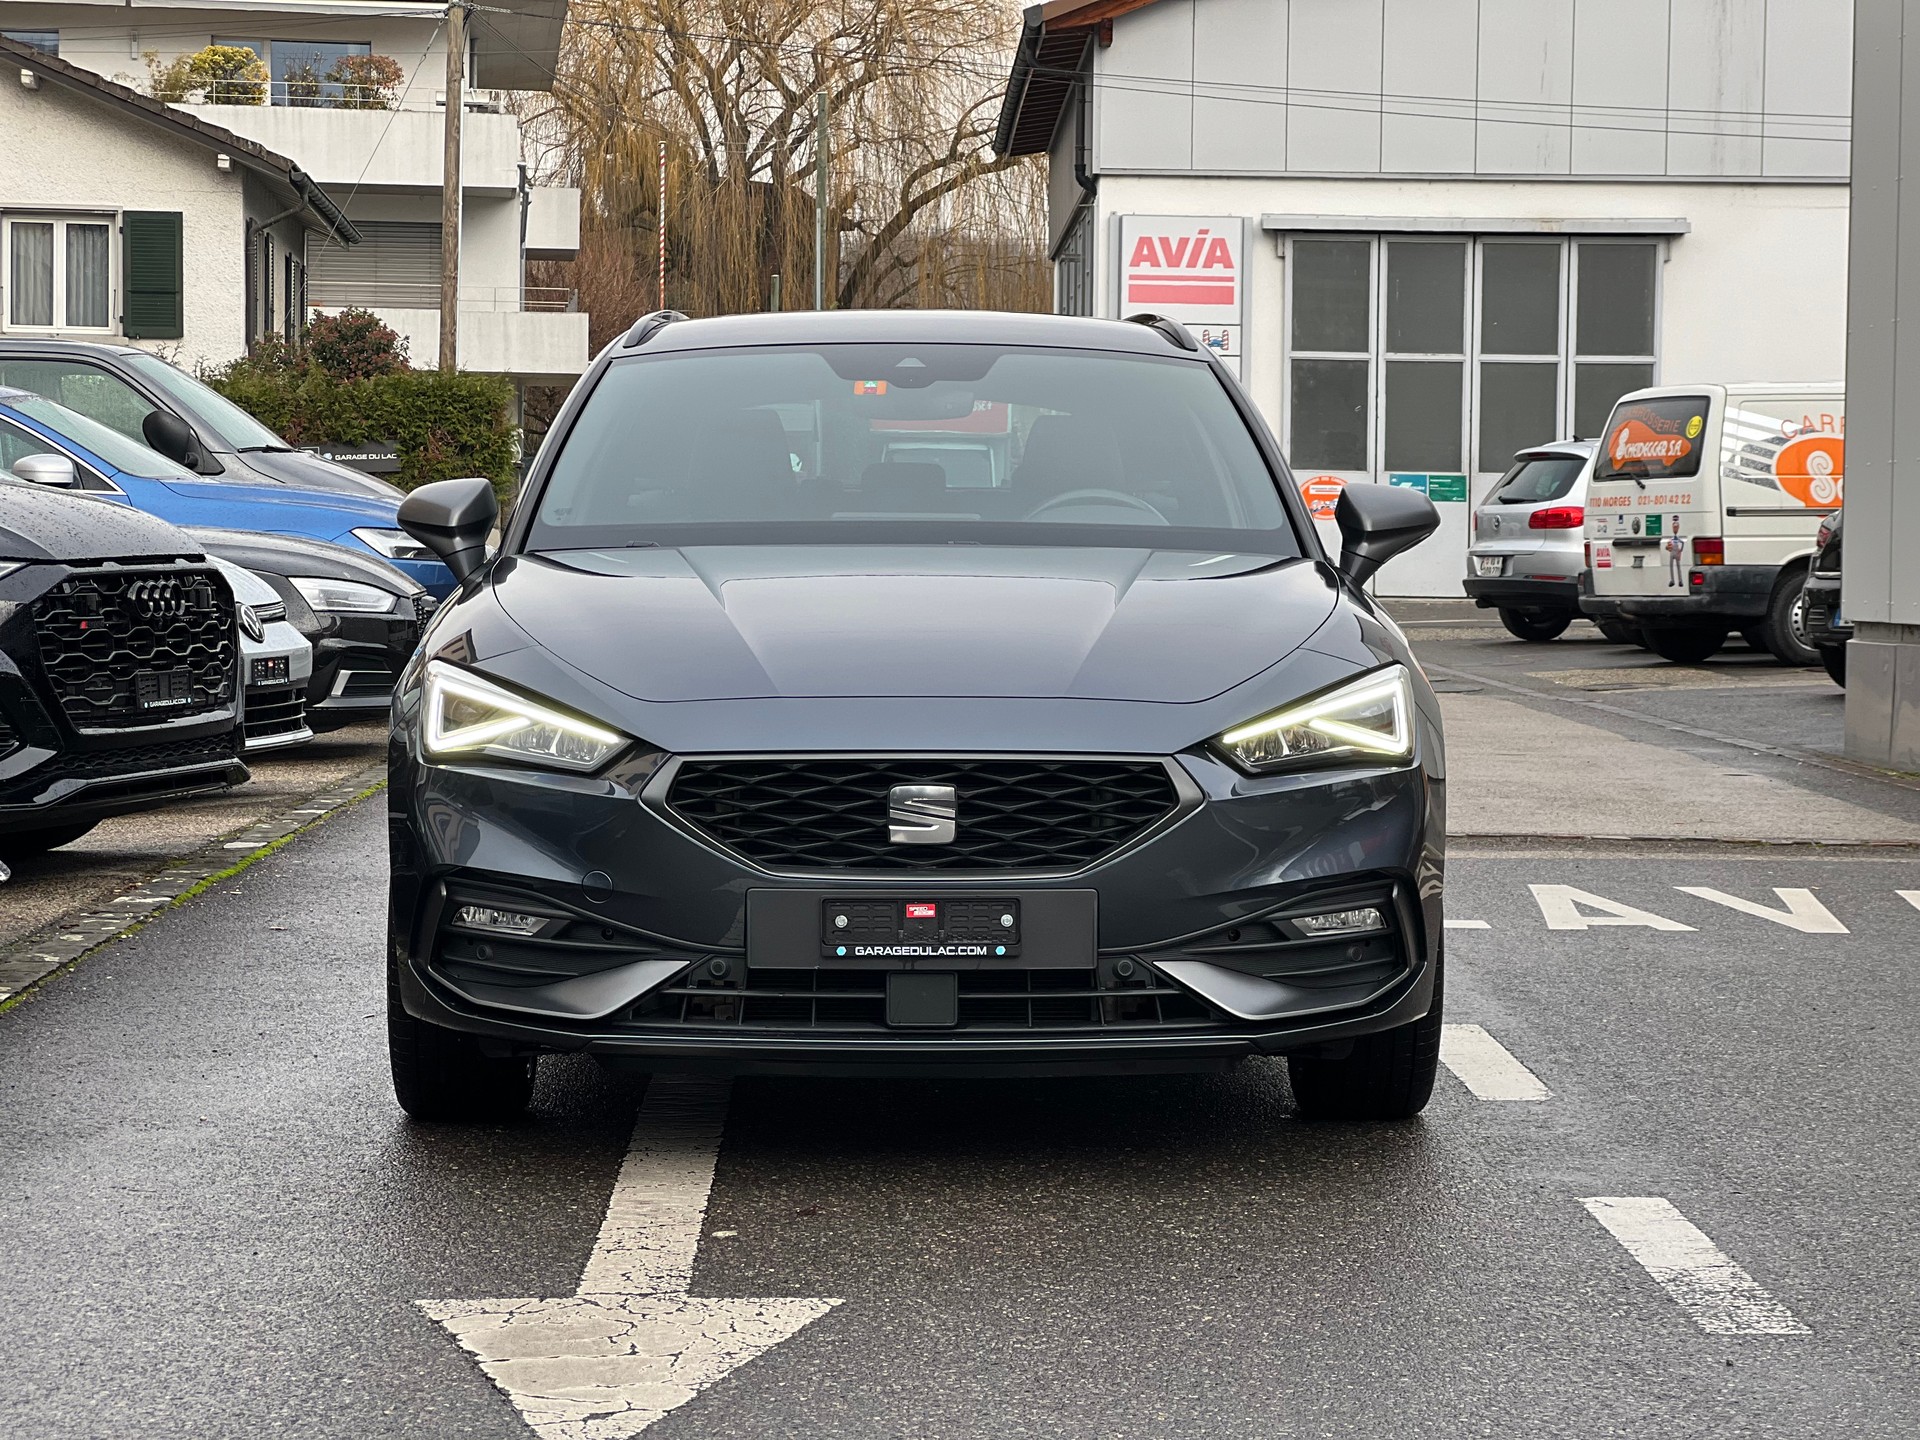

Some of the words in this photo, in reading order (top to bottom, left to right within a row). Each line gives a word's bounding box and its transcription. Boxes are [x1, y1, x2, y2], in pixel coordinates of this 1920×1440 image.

[1602, 496, 1632, 508] MORGES
[1637, 494, 1667, 506] 021-801
[1669, 494, 1679, 504] 42
[1681, 493, 1691, 504] 22
[854, 945, 988, 956] GARAGEDULAC.COM
